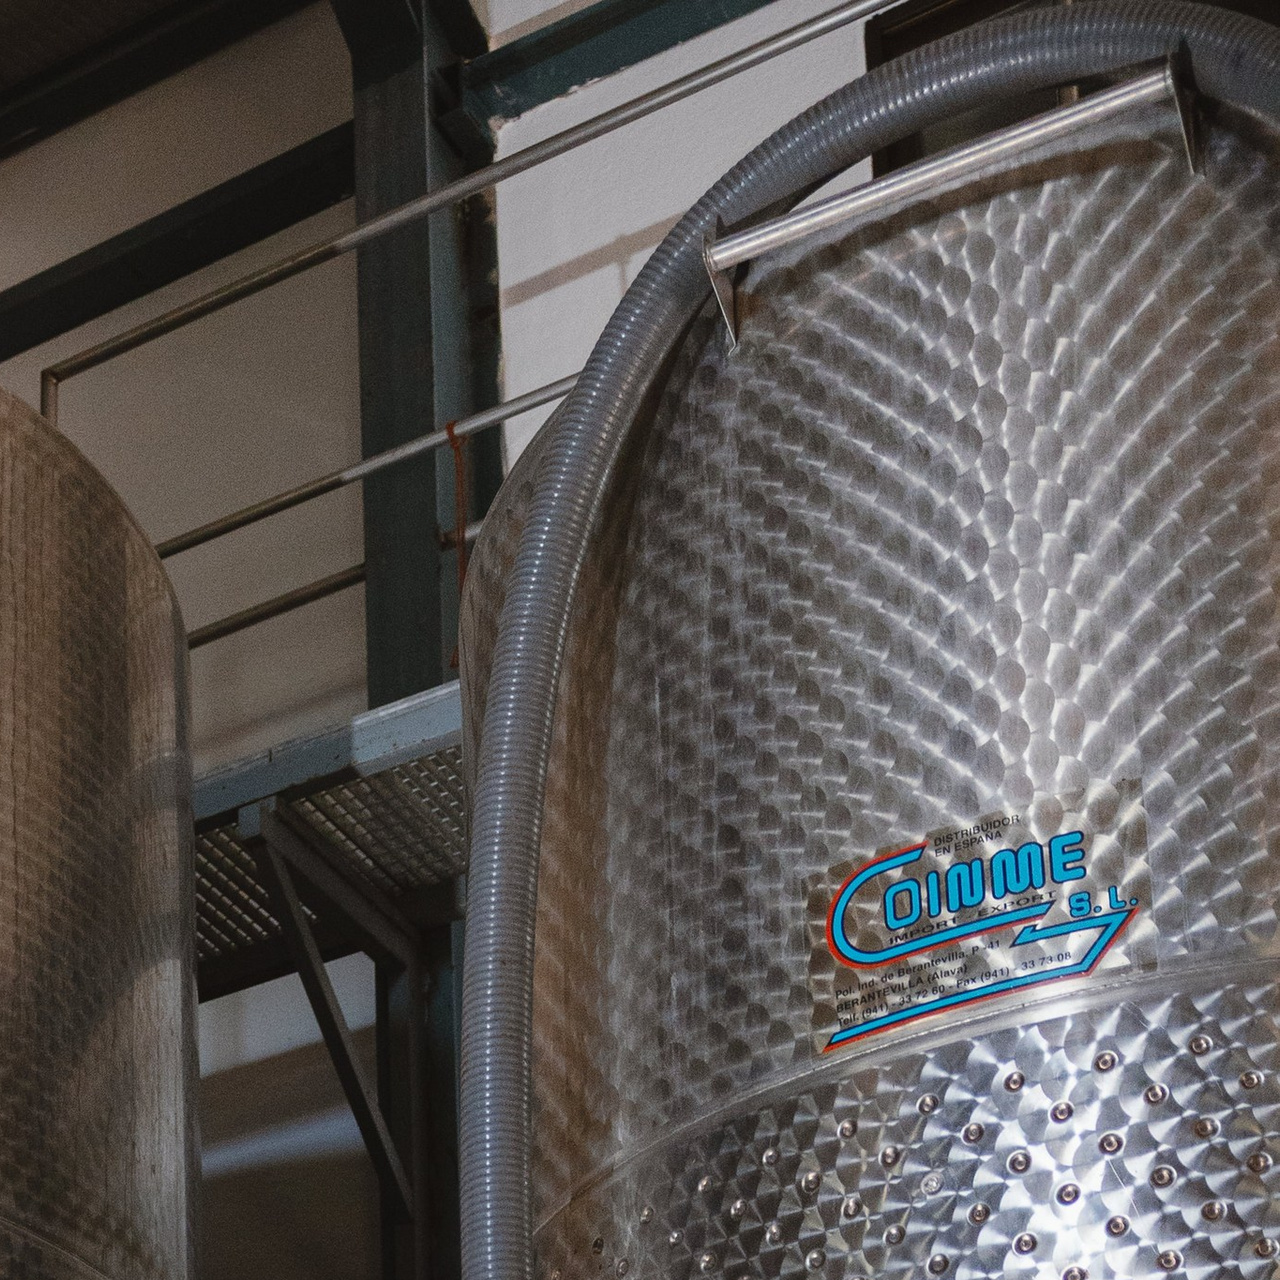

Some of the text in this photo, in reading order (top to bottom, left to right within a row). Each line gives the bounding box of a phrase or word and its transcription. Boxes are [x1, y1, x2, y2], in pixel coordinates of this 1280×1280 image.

[934, 814, 1020, 847] DISTRIBUIDOR
[935, 829, 1002, 857] EN ESPAÑA
[827, 830, 1088, 970] COINME
[889, 916, 962, 945] IMPORT
[978, 890, 1058, 917] EXPORT
[835, 986, 855, 999] Pol.
[858, 979, 878, 991] Ind.
[881, 973, 894, 983] de
[836, 976, 924, 1013] BERANTEVILLA
[862, 1002, 889, 1020] (941)
[898, 996, 912, 1007] 33
[915, 989, 928, 1000] 72
[931, 984, 945, 995] 60
[956, 976, 977, 989] Fax
[981, 967, 1010, 983] (941)
[1021, 960, 1035, 970] 33
[1039, 956, 1053, 966] 73
